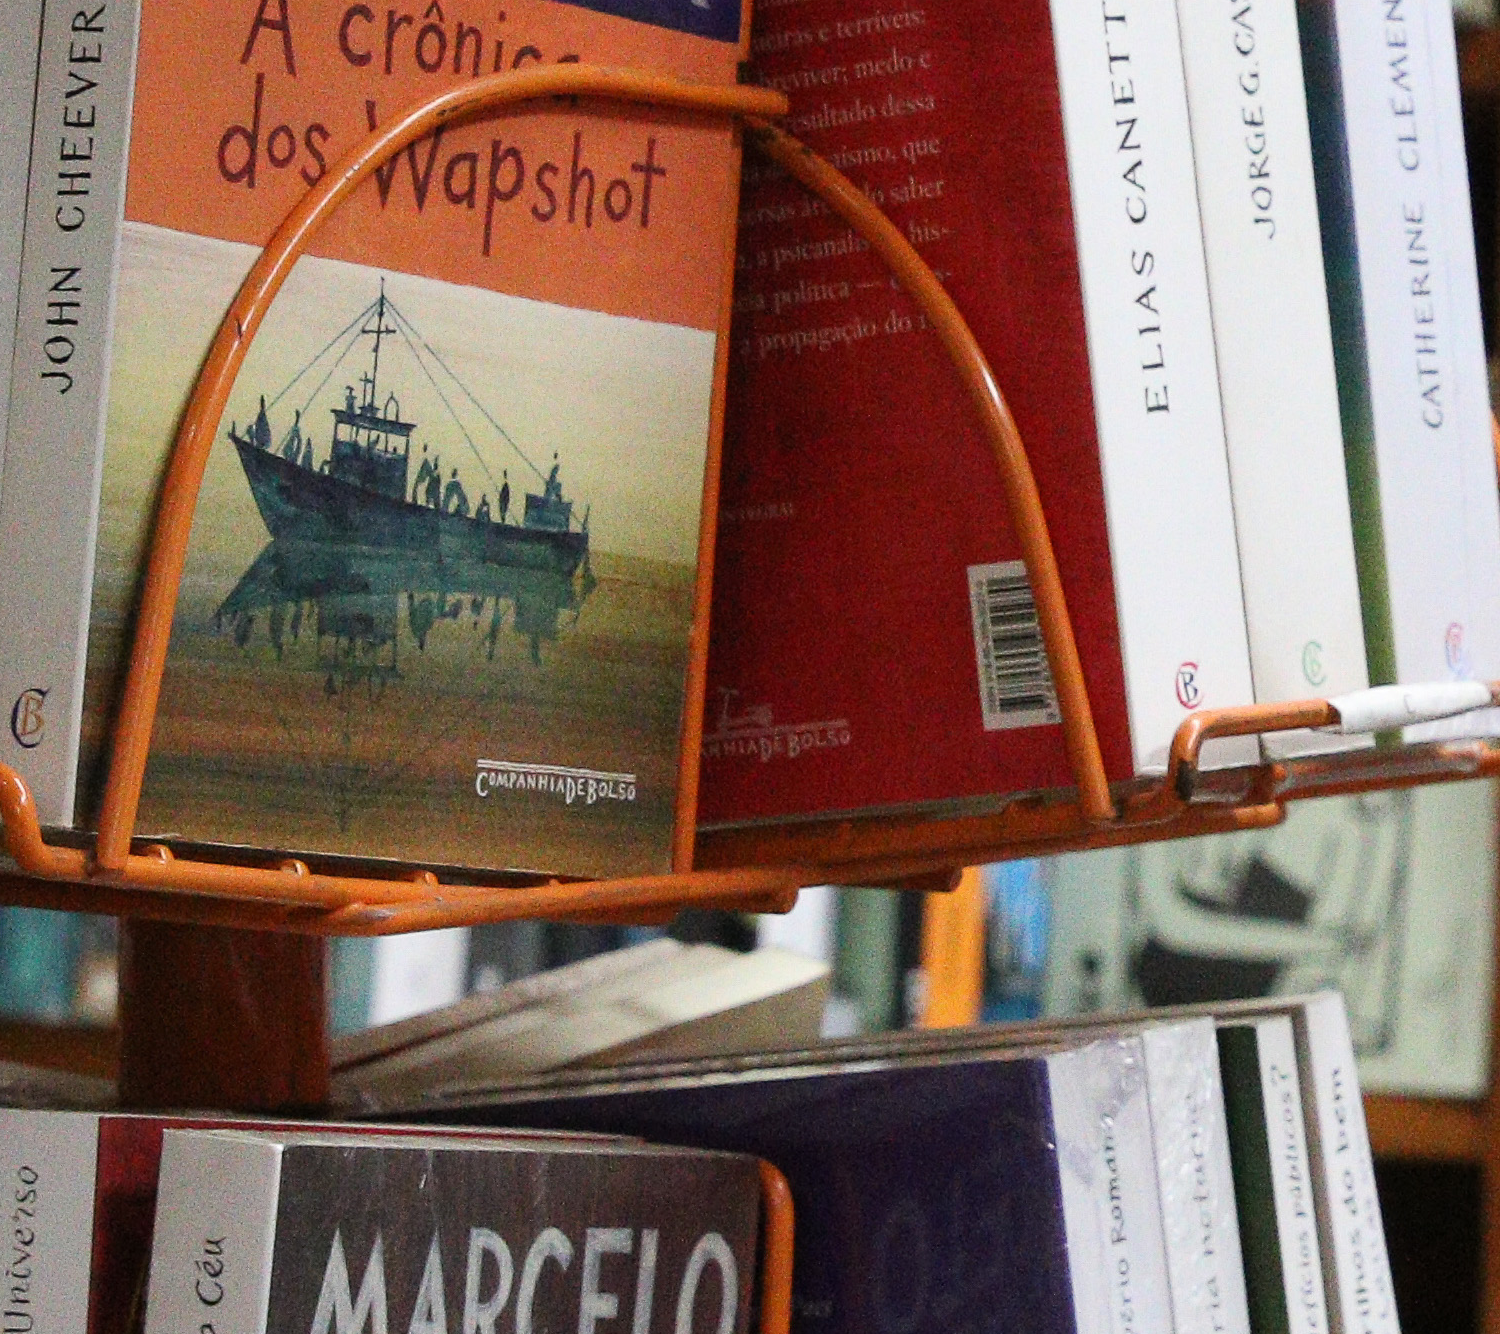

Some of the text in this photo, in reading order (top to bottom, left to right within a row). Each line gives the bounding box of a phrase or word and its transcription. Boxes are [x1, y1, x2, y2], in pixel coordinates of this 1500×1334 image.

[55, 4, 107, 234] CHEEVER
[215, 72, 666, 257] dos Wapshot
[1237, 101, 1276, 240] JORGE
[41, 266, 82, 394] JOHN
[1124, 247, 1171, 416] ELIAS
[1406, 200, 1443, 430] CATHERINE
[194, 1235, 225, 1307] Céu
